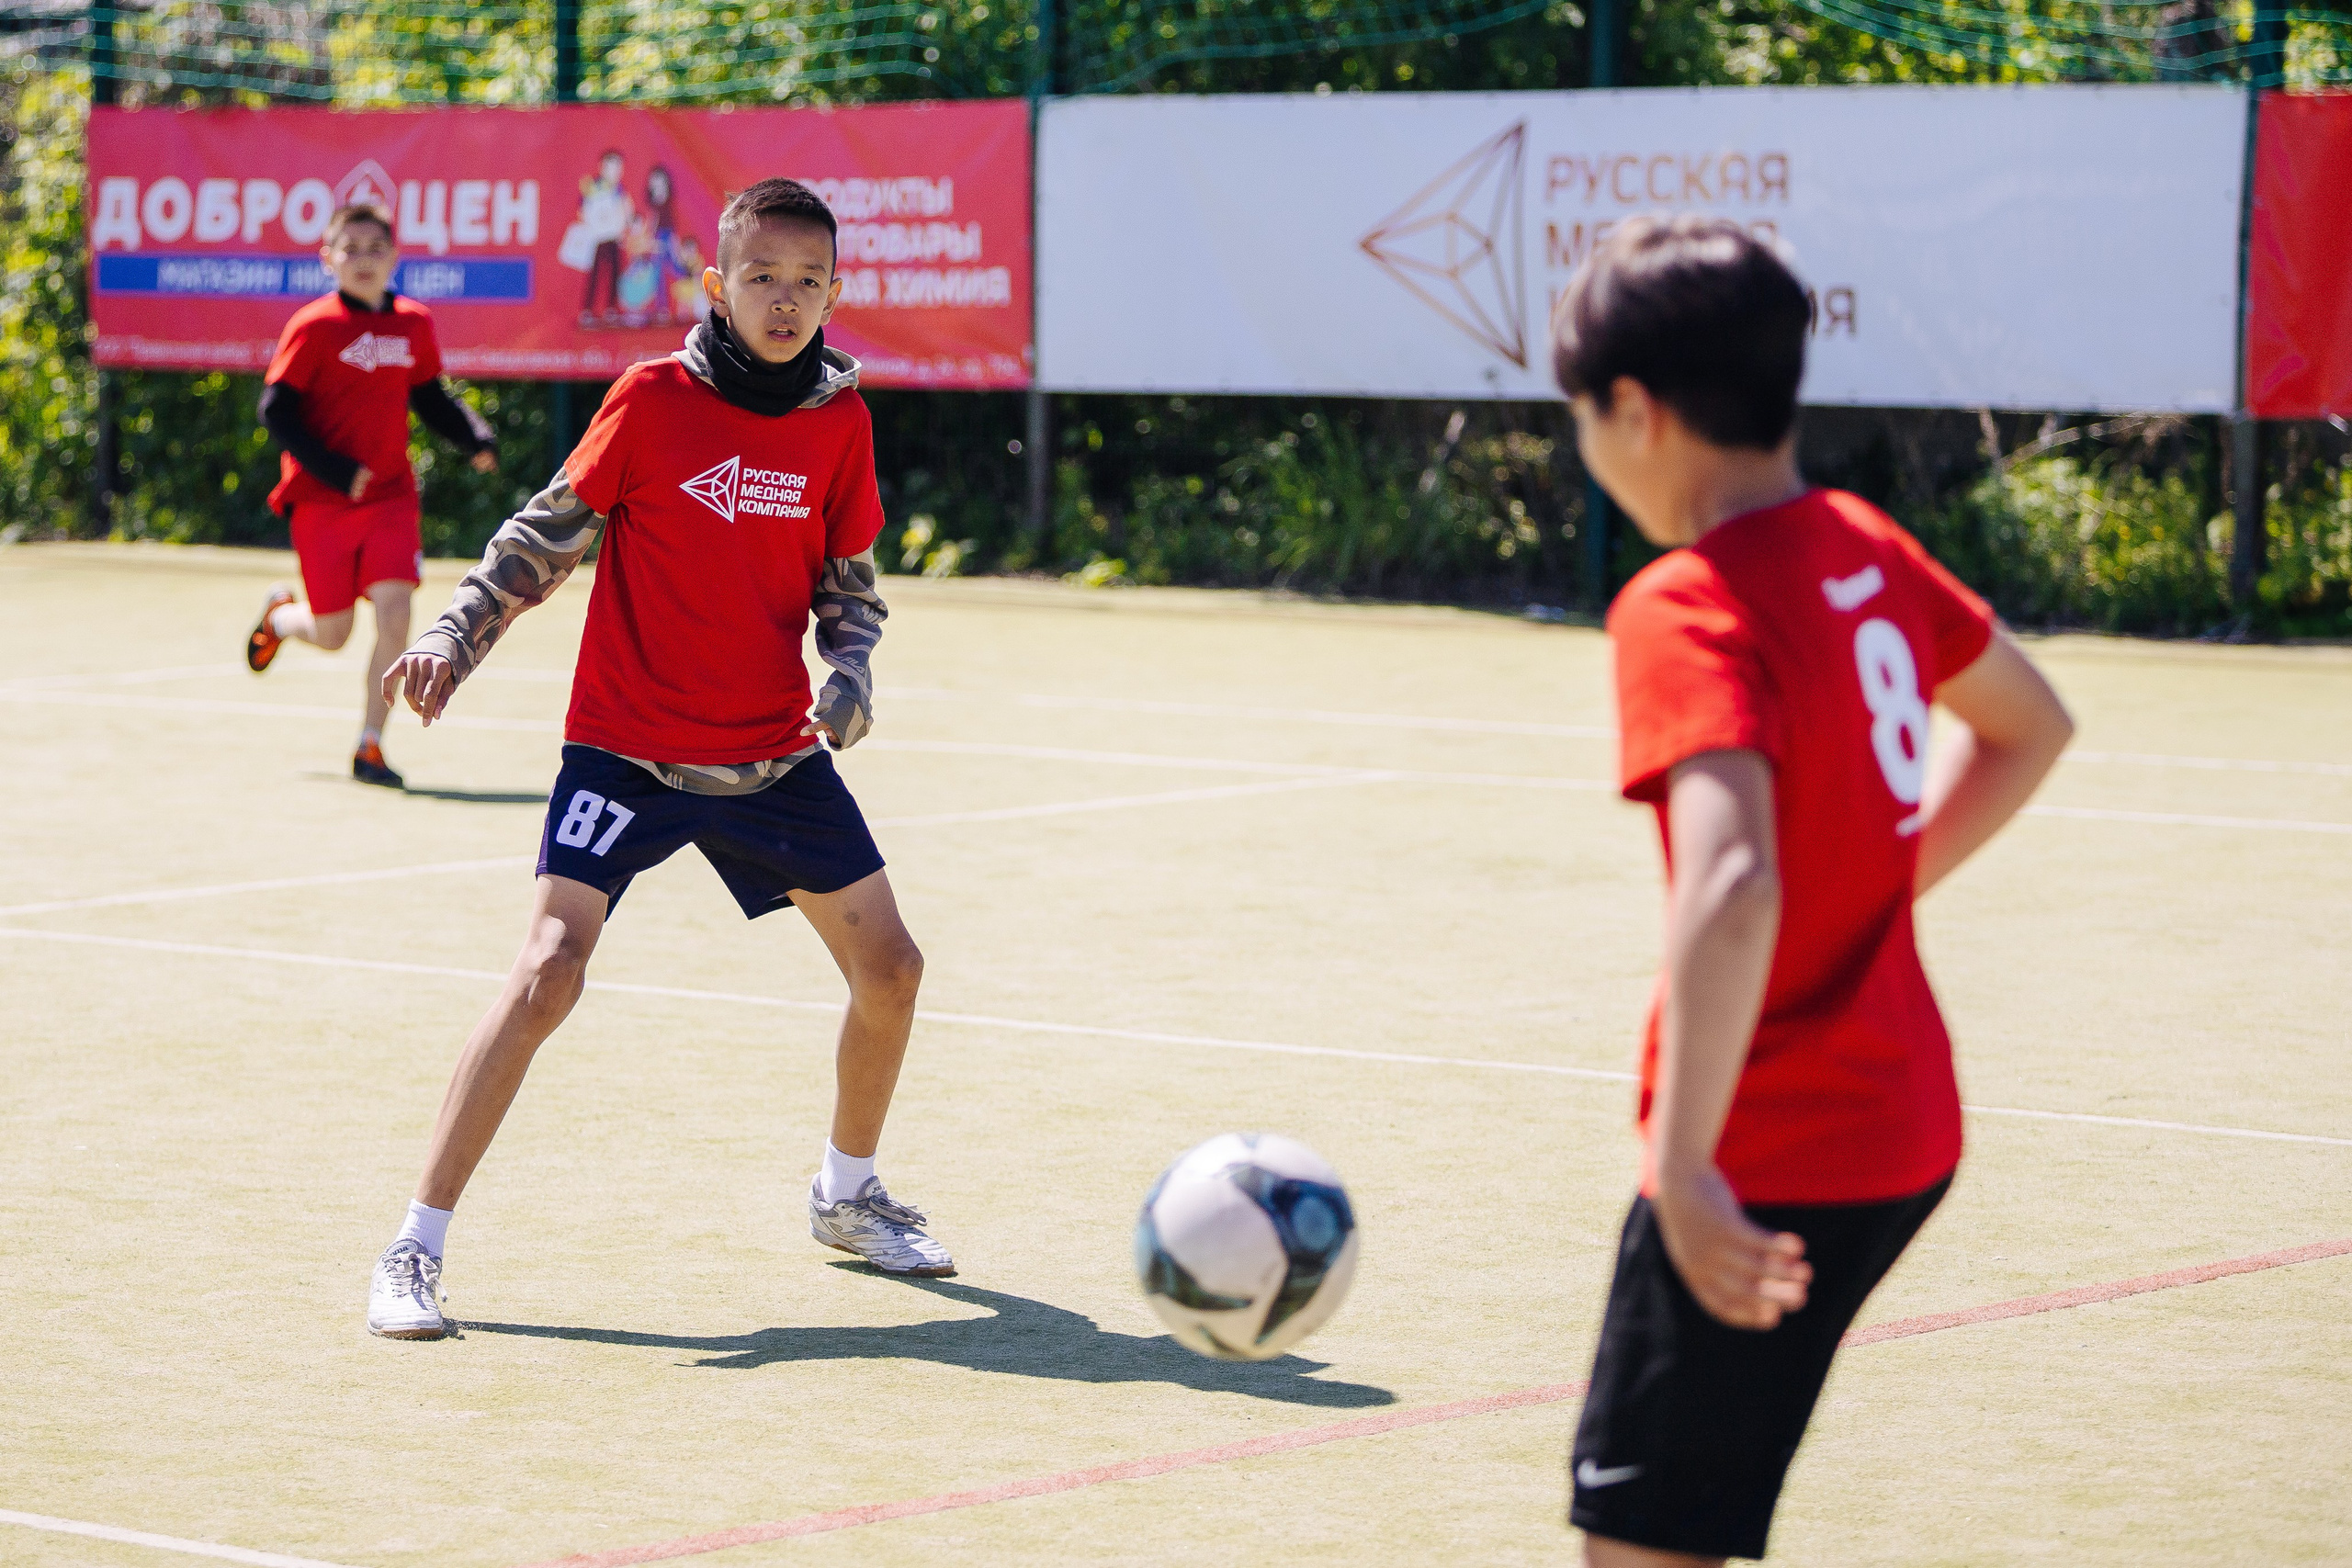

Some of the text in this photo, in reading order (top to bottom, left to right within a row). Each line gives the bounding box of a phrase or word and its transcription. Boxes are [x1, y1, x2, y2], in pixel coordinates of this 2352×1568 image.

[1545, 152, 1792, 205] РУССКАЯ
[797, 176, 955, 222] ОДУКТЫ
[741, 483, 802, 503] МЕДНАЯ
[742, 468, 808, 490] РУССКАЯ
[737, 499, 811, 519] КОМПАНИЯ
[556, 789, 637, 857] 87
